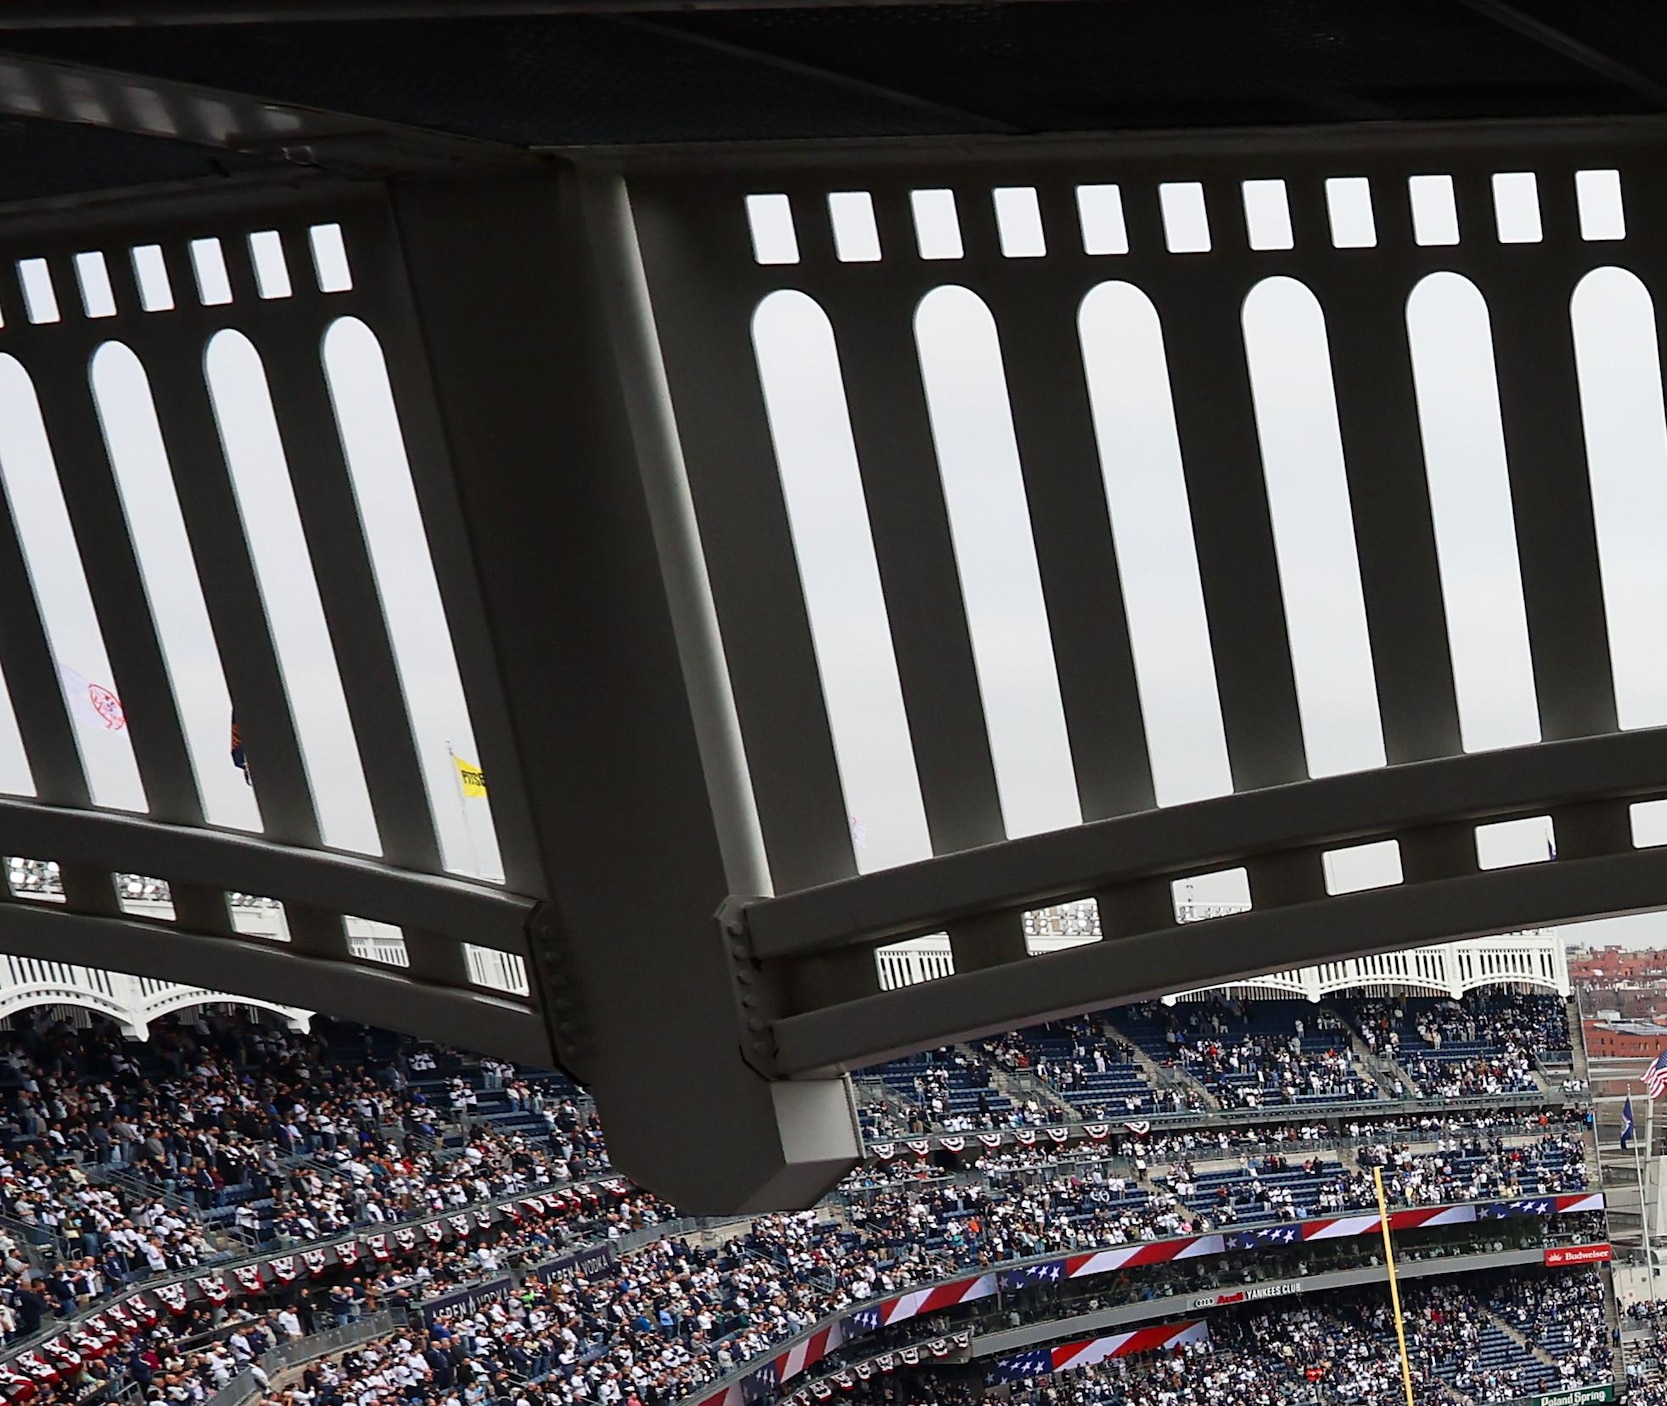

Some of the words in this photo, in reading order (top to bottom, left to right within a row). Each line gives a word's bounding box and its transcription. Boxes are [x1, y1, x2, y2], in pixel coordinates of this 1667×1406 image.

[1565, 1250, 1609, 1261] Budweiser
[1217, 1292, 1244, 1304] Audi
[1246, 1286, 1281, 1300] YANKEES
[1282, 1283, 1301, 1294] CLUB
[1576, 1389, 1606, 1406] Spring
